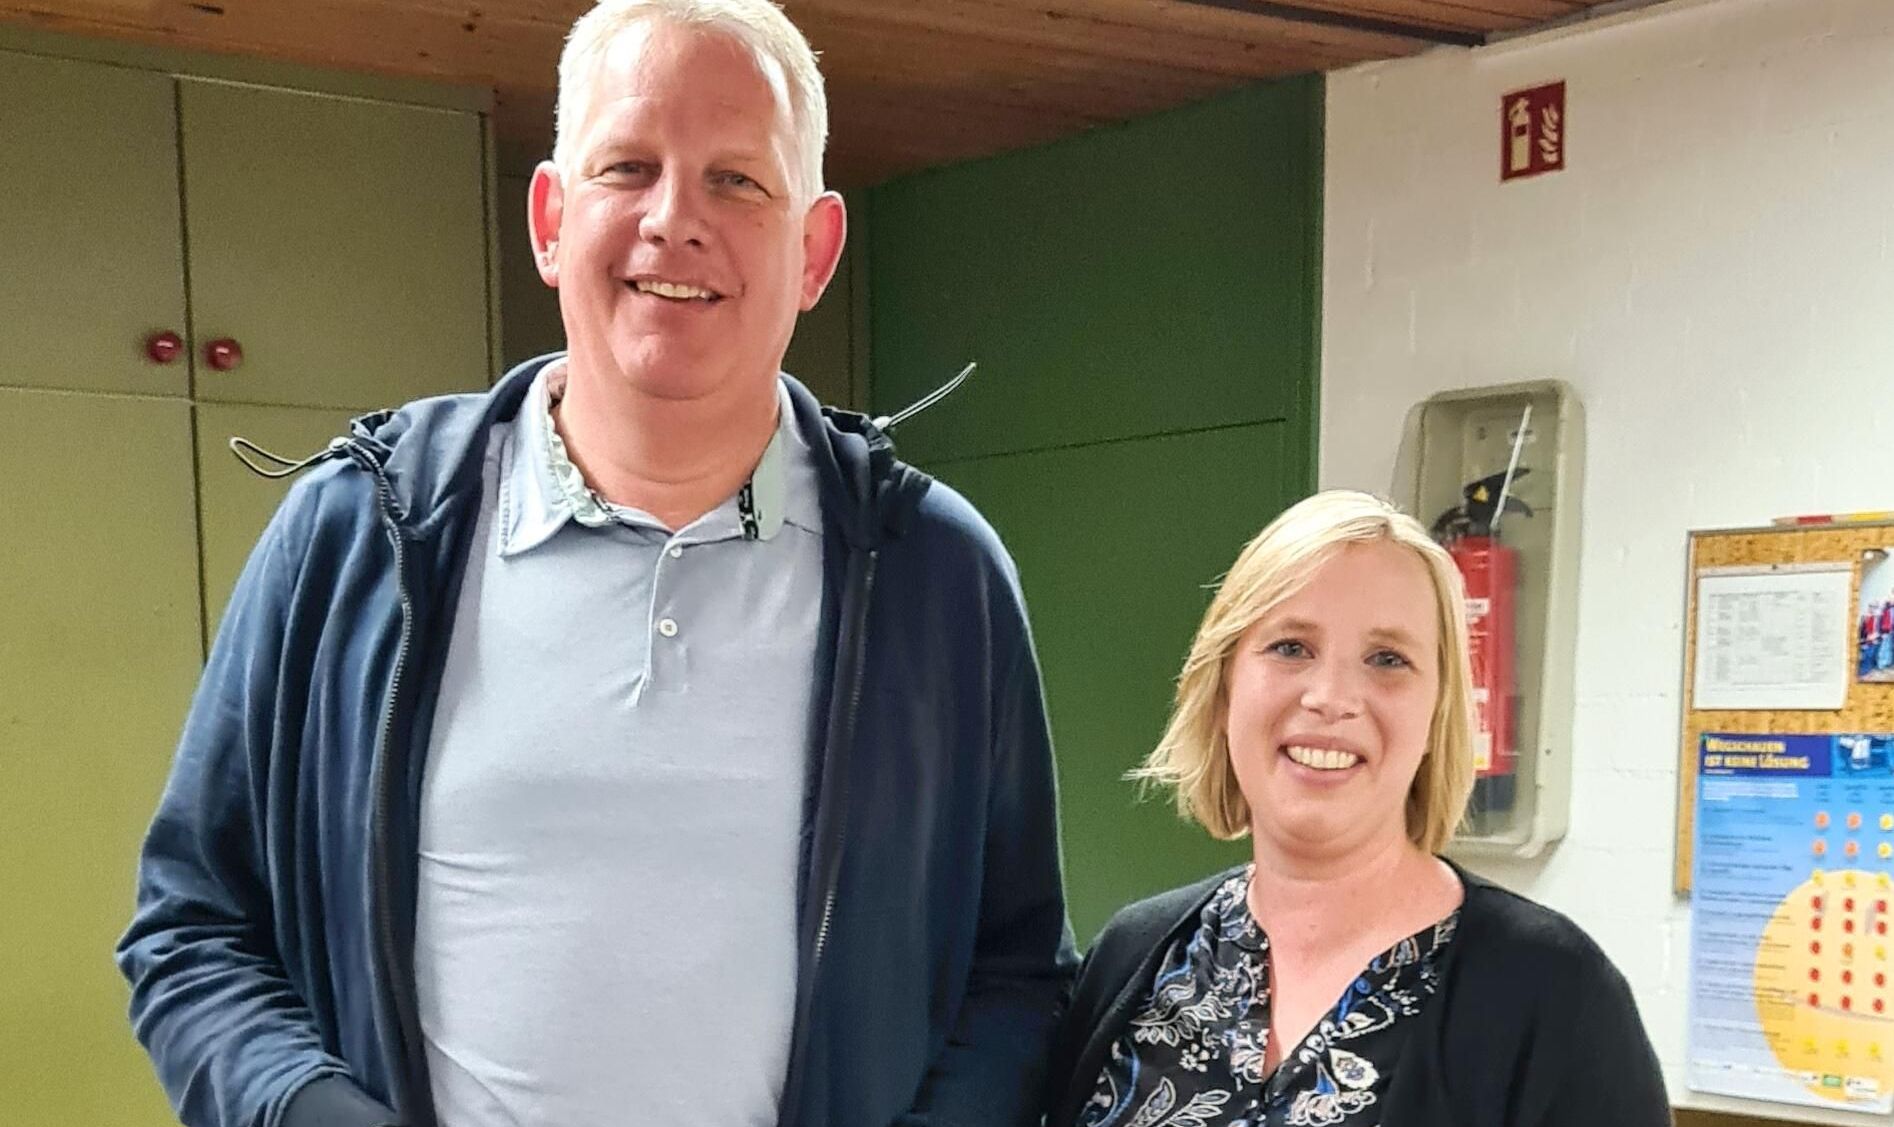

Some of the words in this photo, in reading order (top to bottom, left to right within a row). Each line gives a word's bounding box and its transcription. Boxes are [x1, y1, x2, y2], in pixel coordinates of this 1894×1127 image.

[1705, 737, 1786, 754] WEGSCHAUEN
[1703, 754, 1722, 767] IST
[1724, 755, 1757, 768] KEINE
[1758, 753, 1811, 770] LÖSUNG
